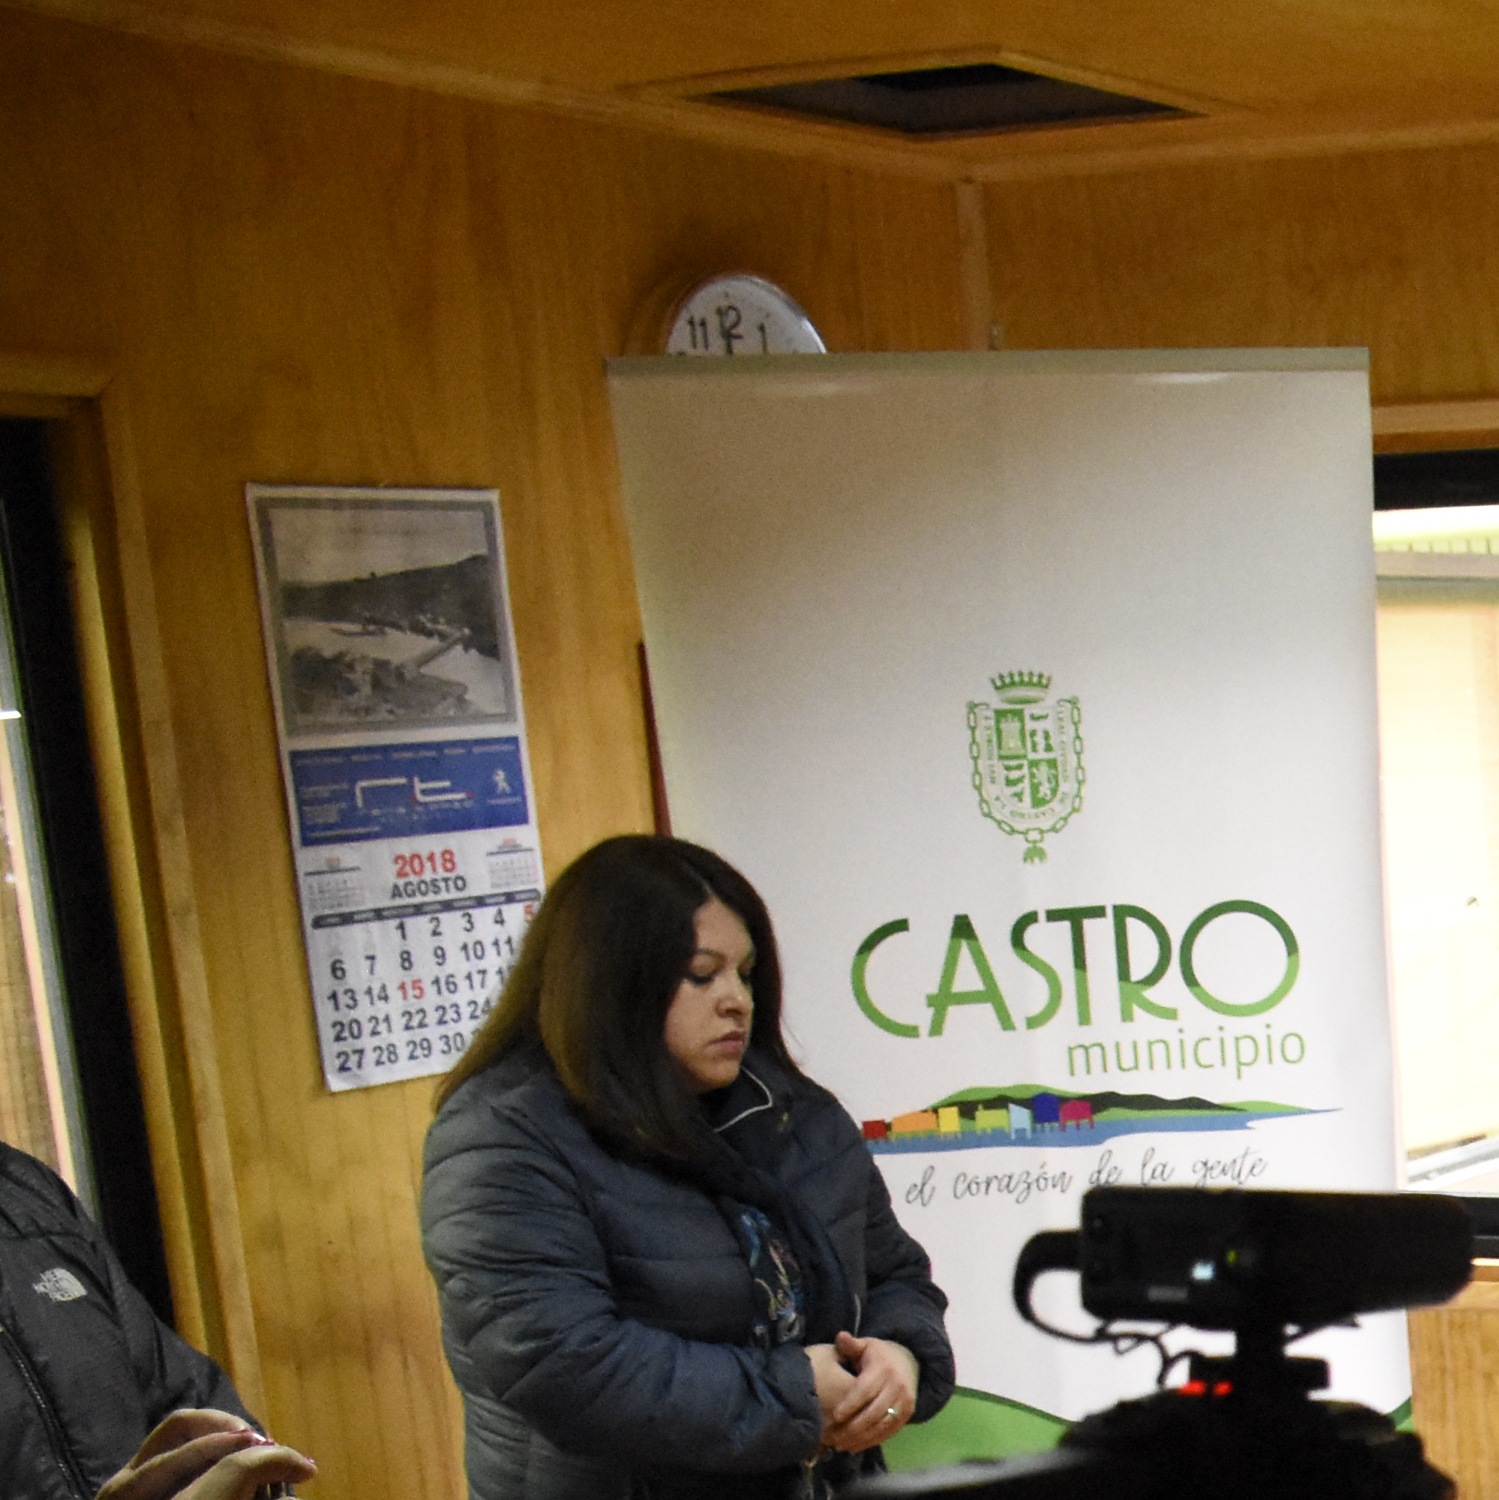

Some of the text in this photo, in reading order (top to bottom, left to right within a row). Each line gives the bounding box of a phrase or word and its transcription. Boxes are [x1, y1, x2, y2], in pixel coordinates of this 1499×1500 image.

[393, 849, 457, 878] 2018
[390, 875, 468, 900] AGOSTO
[395, 920, 407, 941] 1
[429, 916, 442, 937] 2
[461, 912, 475, 932] 3
[493, 908, 505, 927] 4
[330, 935, 514, 980] 6 7 8 9 10 11
[851, 899, 1300, 1038] CASTRO
[327, 988, 358, 1012] 13
[364, 983, 390, 1006] 14
[397, 978, 425, 1000] 15
[431, 974, 458, 996] 16
[463, 969, 488, 991] 17
[331, 1018, 363, 1043] 20
[367, 1014, 393, 1037] 21
[401, 1008, 429, 1031] 22
[435, 1003, 462, 1026] 23
[335, 1048, 365, 1074] 27
[372, 1043, 398, 1067] 28
[406, 1037, 432, 1061] 29
[438, 1032, 466, 1055] 30
[1066, 1024, 1307, 1080] municipio
[905, 1164, 937, 1206] el
[953, 1161, 1076, 1205] corazón
[1138, 1146, 1175, 1187] la
[1191, 1146, 1270, 1187] gente
